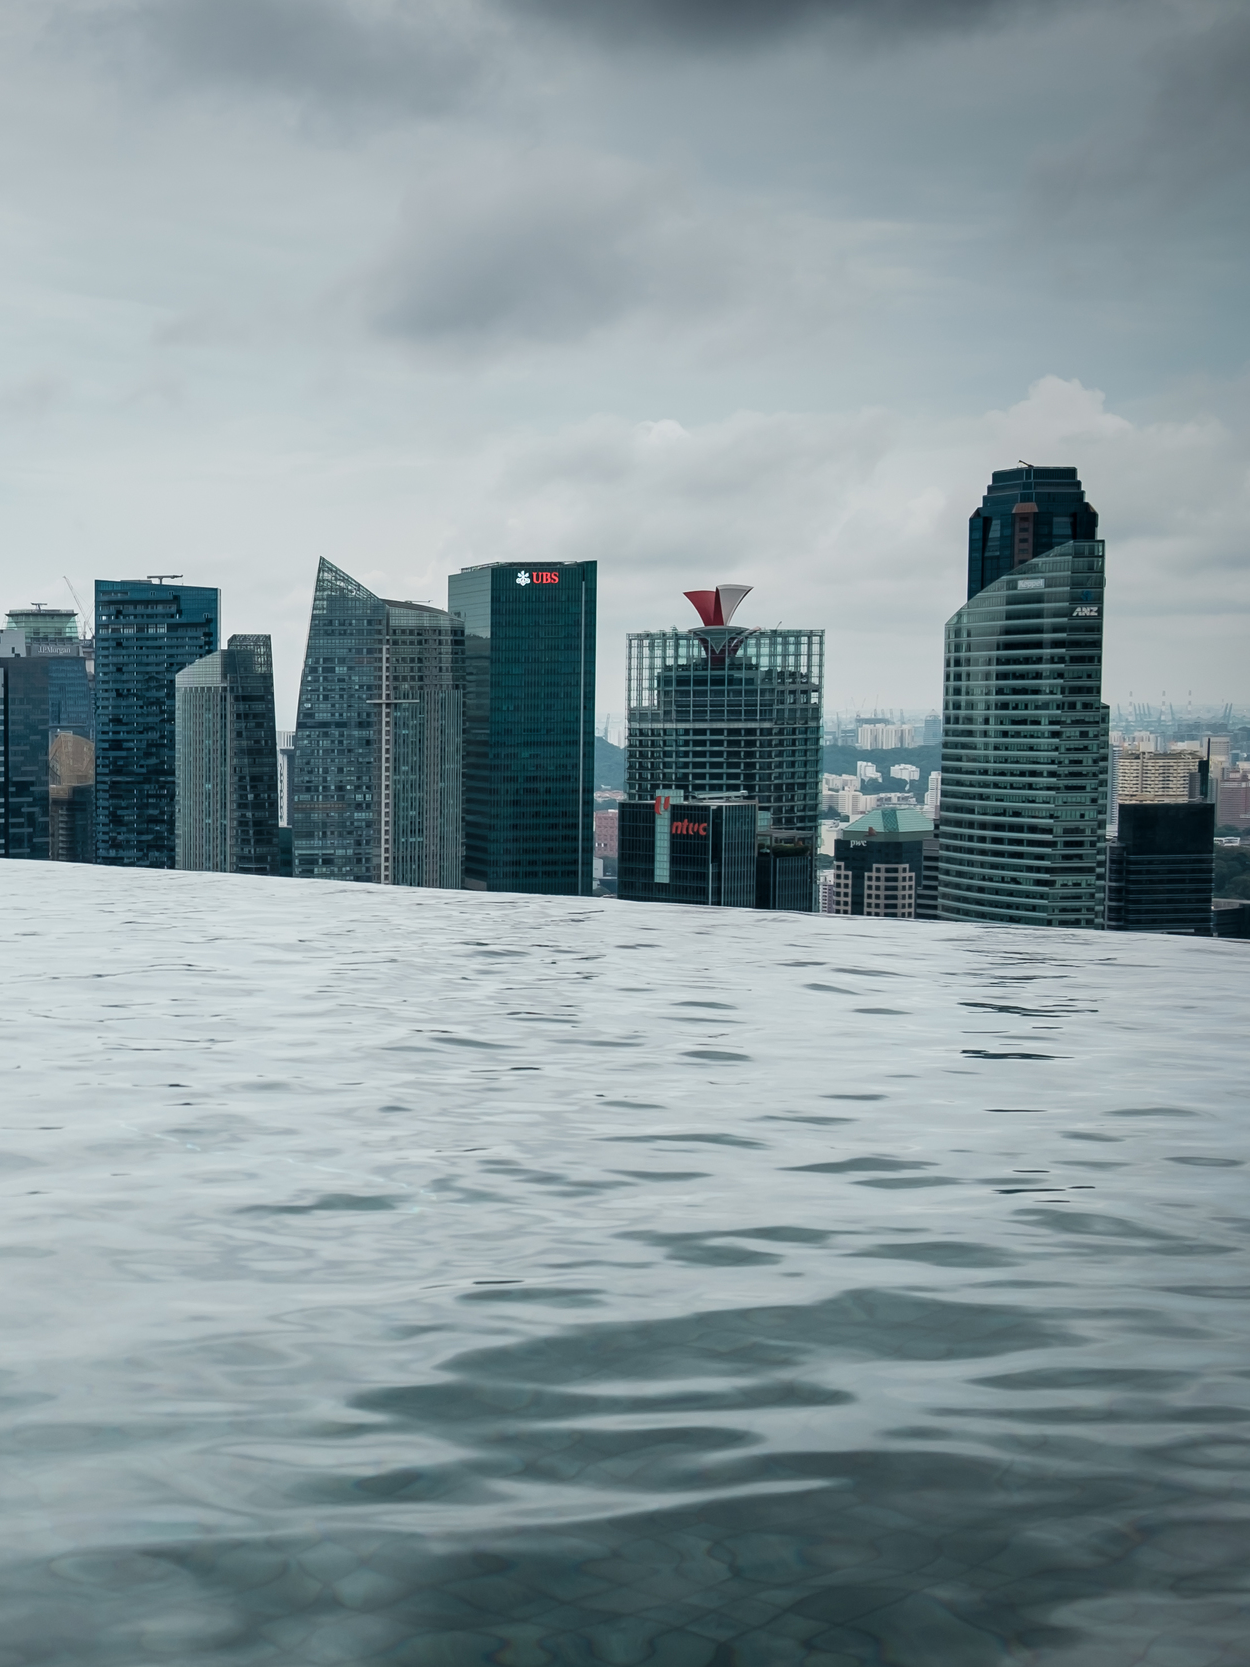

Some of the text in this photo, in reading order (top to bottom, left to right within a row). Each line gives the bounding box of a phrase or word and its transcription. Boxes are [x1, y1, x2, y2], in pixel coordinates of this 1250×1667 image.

[532, 571, 559, 584] UBS
[1072, 606, 1098, 616] ANZ
[672, 818, 707, 836] ntuc
[850, 839, 867, 848] pwc
